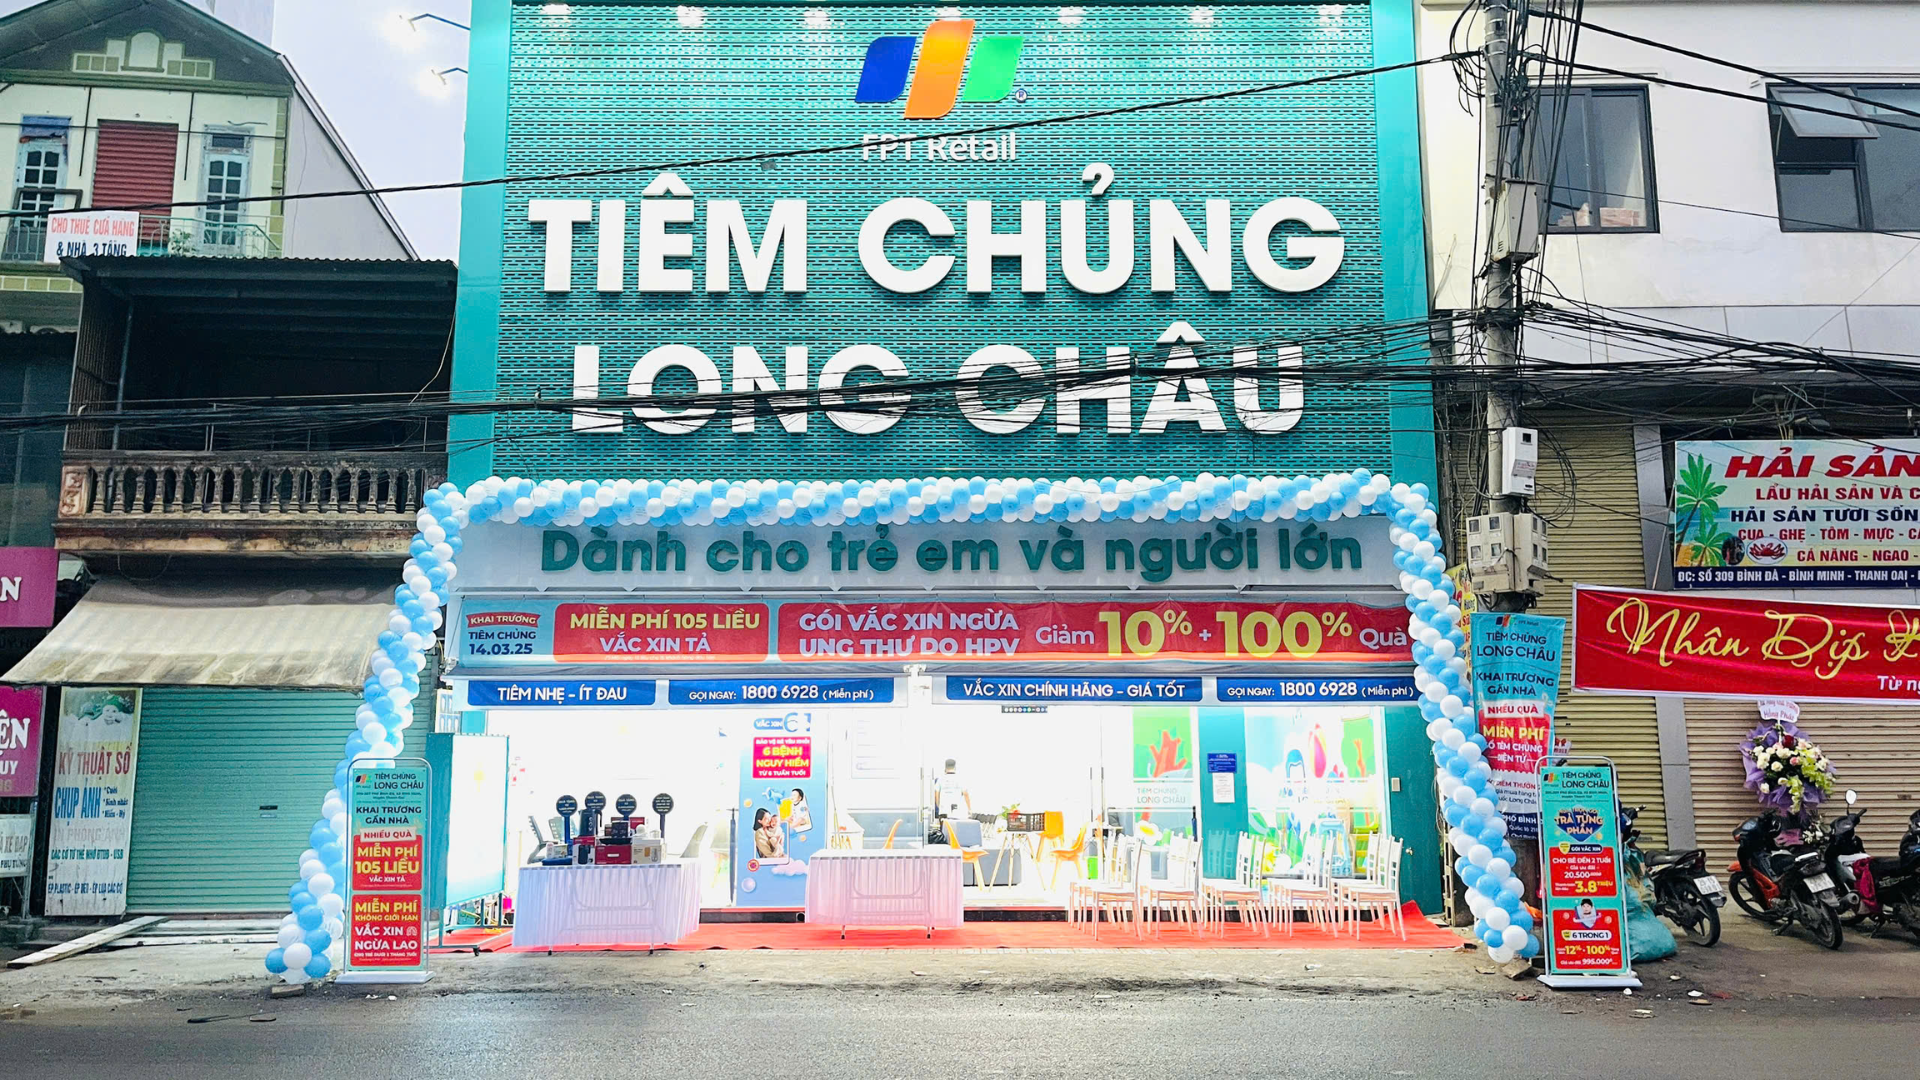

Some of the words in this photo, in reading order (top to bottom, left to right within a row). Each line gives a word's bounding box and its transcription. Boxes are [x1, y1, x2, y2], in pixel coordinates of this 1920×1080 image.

[863, 134, 917, 161] FPT
[928, 132, 1016, 161] Retail
[51, 216, 68, 234] CHO
[527, 171, 808, 293] TIÊM
[857, 162, 1346, 294] CHỦNG
[57, 241, 63, 257] &
[572, 343, 912, 436] LONG
[954, 321, 1305, 436] CHÂU
[1724, 446, 1815, 478] HẢI
[1824, 446, 1920, 478] SẢN
[1797, 484, 1829, 501] HẢI
[1835, 483, 1874, 501] SẢN
[1880, 485, 1903, 500] VÀ
[1730, 506, 1766, 522] HẢI
[1773, 506, 1816, 522] SẢN
[1823, 508, 1869, 522] TƯƠI
[1738, 528, 1764, 541] CUA
[1779, 528, 1806, 543] GHẸ
[1820, 526, 1850, 541] TÔM
[1863, 528, 1895, 543] MỰC
[541, 526, 687, 572] Dành
[705, 530, 809, 573] cho
[827, 523, 900, 573] trẻ
[916, 538, 999, 572] em
[1018, 524, 1085, 572] và
[1104, 522, 1259, 583] người
[1278, 522, 1363, 572] lớn
[1797, 547, 1816, 562] CÁ
[1872, 549, 1909, 562] NGAO
[1678, 571, 1696, 582] ĐC:
[1698, 567, 1713, 582] SỐ
[1715, 570, 1734, 582] 309
[1736, 569, 1762, 582] BÌNH
[1764, 568, 1779, 582] ĐÀ
[1789, 568, 1814, 581] BÌNH
[1817, 570, 1845, 581] MINH
[1855, 570, 1888, 581] THANH
[1891, 570, 1908, 581] OAI
[470, 615, 495, 625] KHAI
[496, 613, 537, 625] TRƯƠNG
[570, 607, 629, 630] MIỄN
[631, 609, 670, 630] PHÍ
[673, 613, 708, 630] 105
[713, 608, 761, 630] LIỀU
[800, 609, 842, 631] GÓI
[848, 606, 898, 631] VẮC
[903, 612, 943, 631] XIN
[950, 609, 1019, 631] NGỪA
[468, 630, 495, 640] TIÊM
[497, 628, 537, 640] CHỦNG
[1035, 625, 1094, 645] Giảm
[1098, 608, 1194, 658] 10%
[1216, 610, 1353, 659] 100%
[1359, 628, 1408, 650] Quà
[1486, 631, 1509, 642] TIÊM
[1510, 631, 1547, 645] CHỦNG
[1605, 597, 1750, 668] Nhân
[1761, 608, 1869, 680] Dịp
[469, 643, 533, 655] 14.03.25
[600, 631, 645, 653] VẮC
[647, 637, 681, 653] XIN
[685, 631, 711, 652] TẢ
[800, 638, 855, 658] UNG
[860, 635, 917, 657] THƯ
[920, 637, 960, 657] DO
[965, 637, 1020, 657] HPV
[1477, 645, 1514, 657] LONG
[1515, 645, 1556, 662] CHÂU
[1476, 672, 1504, 682] KHAI
[1505, 671, 1555, 687] TRƯƠNG
[1877, 675, 1903, 691] Từ
[497, 685, 532, 701] TIÊM
[535, 687, 565, 705] NHẸ
[579, 684, 594, 701] ÍT
[596, 686, 627, 701] ĐAU
[689, 690, 707, 703] GỌI
[708, 690, 737, 700] NGAY:
[742, 684, 778, 700] 1800
[781, 685, 819, 699] 6928
[963, 679, 990, 696] VẮC
[998, 682, 1022, 697] XIN
[1024, 680, 1068, 697] CHÍNH
[1071, 682, 1113, 697] HÃNG
[1127, 680, 1152, 697] GIÁ
[1156, 679, 1185, 697] TỐT
[1227, 686, 1246, 699] GỌI
[1248, 686, 1275, 697] NGAY:
[1279, 682, 1315, 697] 1800
[1319, 682, 1357, 697] 6928
[1512, 686, 1537, 697] NHÀ
[1517, 703, 1539, 714] QUÀ
[1483, 720, 1515, 739] MIỄN
[1519, 726, 1546, 740] PHÍ
[763, 747, 771, 756] 6
[772, 745, 803, 757] BỆNH
[1512, 742, 1543, 753] CHỦNG
[78, 746, 112, 780] THUẬT
[115, 742, 132, 775] SỐ
[756, 759, 783, 767] NGUY
[784, 757, 809, 767] HIỂM
[375, 772, 390, 780] TIÊM
[391, 772, 416, 780] CHỦNG
[1562, 771, 1577, 779] TIÊM
[1577, 771, 1602, 779] CHỦNG
[374, 781, 398, 789] LONG
[400, 780, 424, 789] CHÂU
[1587, 780, 1610, 788] CHÂU
[55, 787, 80, 826] CHỤP
[81, 777, 102, 819] ẢNH
[1137, 795, 1161, 804] LONG
[1162, 794, 1186, 804] CHÂU
[382, 806, 422, 814] TRƯƠNG
[365, 815, 386, 825] GẦN
[388, 815, 409, 824] NHÀ
[1518, 815, 1537, 824] BÌNH
[1555, 812, 1573, 825] TRẢ
[1575, 813, 1603, 825] TỪNG
[364, 830, 390, 839] NHIỀU
[393, 830, 412, 839] QUÀ
[357, 842, 391, 857] MIỄN
[394, 844, 418, 857] PHÍ
[355, 861, 381, 874] 105
[384, 856, 420, 874] LIỀU
[1575, 880, 1597, 893] 3.8
[355, 898, 390, 913] MIỄN
[394, 899, 418, 913] PHÍ
[355, 922, 380, 936] VẮC
[383, 926, 404, 936] XIN
[354, 938, 390, 950] NGỪA
[392, 940, 418, 950] LAO
